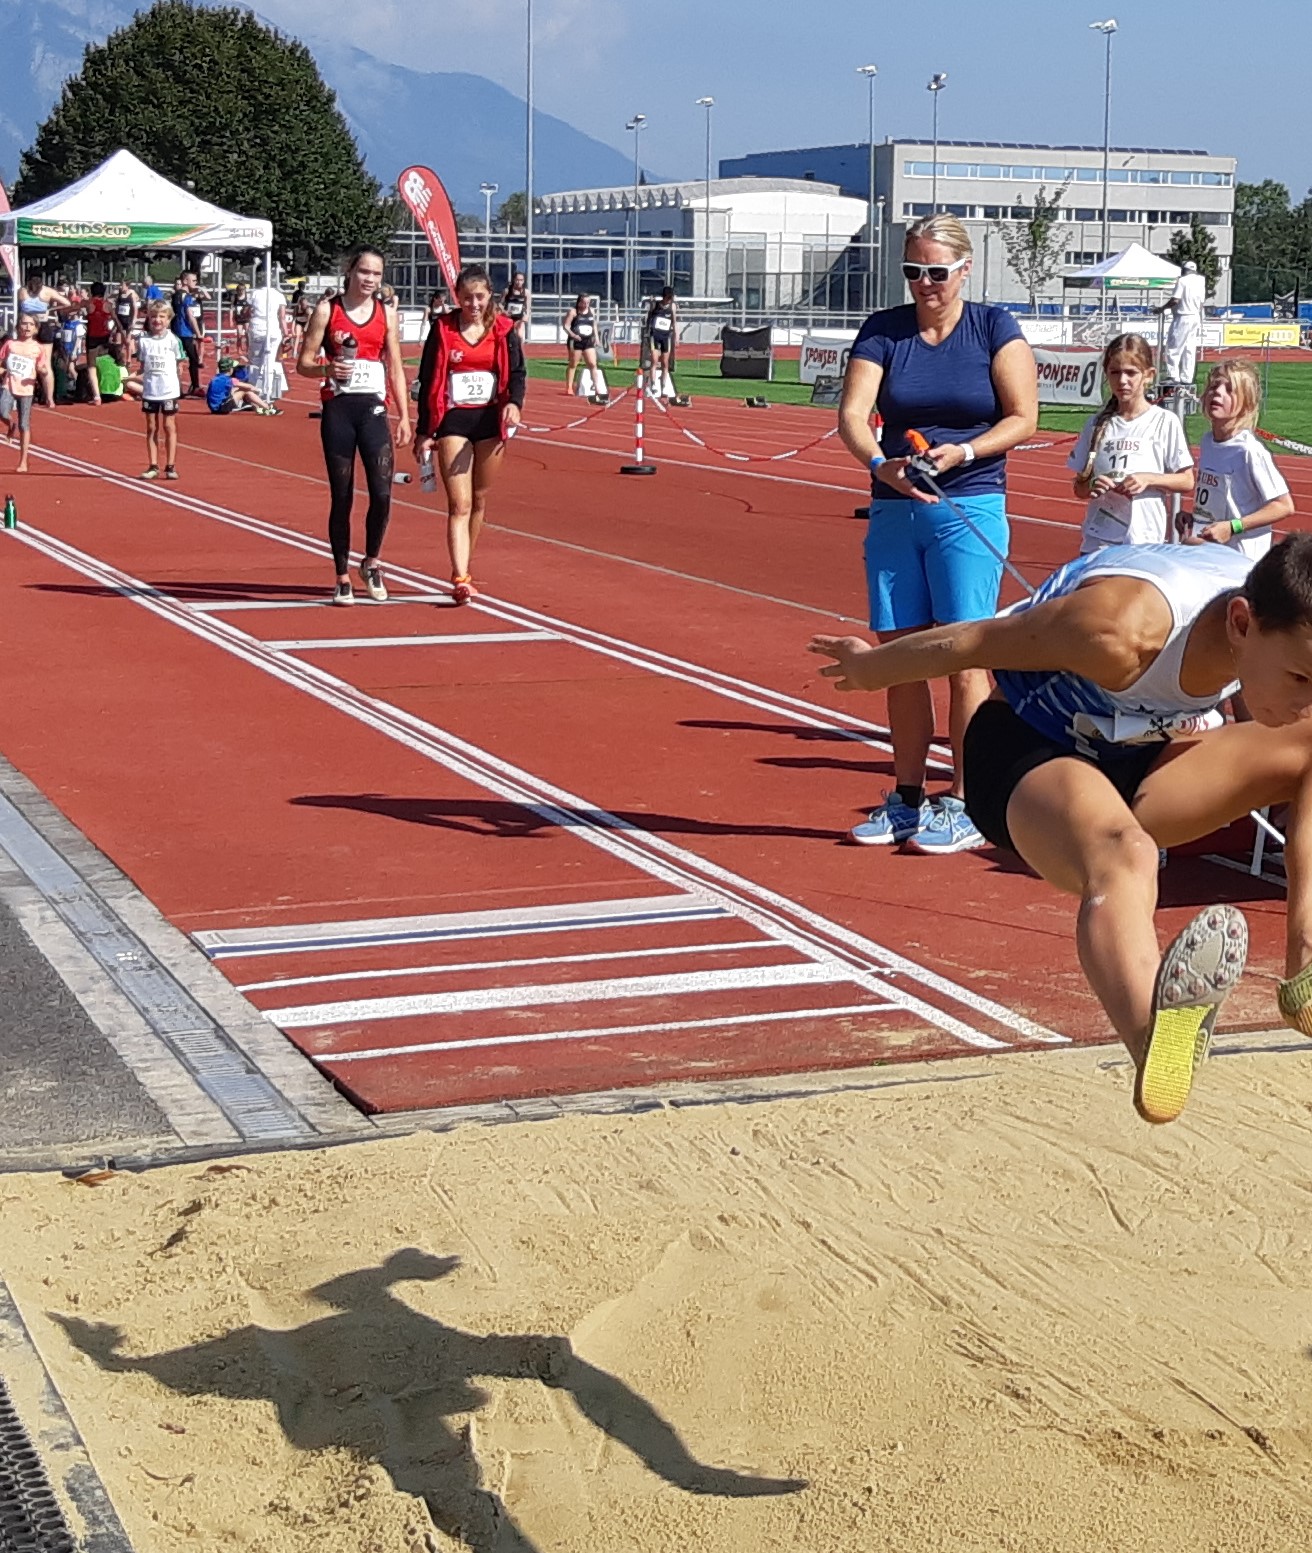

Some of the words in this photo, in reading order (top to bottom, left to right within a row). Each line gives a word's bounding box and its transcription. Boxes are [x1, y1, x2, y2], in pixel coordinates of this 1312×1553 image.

[1035, 362, 1081, 389] PONSER
[467, 384, 485, 396] 23
[1116, 440, 1141, 452] UBS
[1108, 453, 1129, 470] 11
[1201, 471, 1220, 488] UBS
